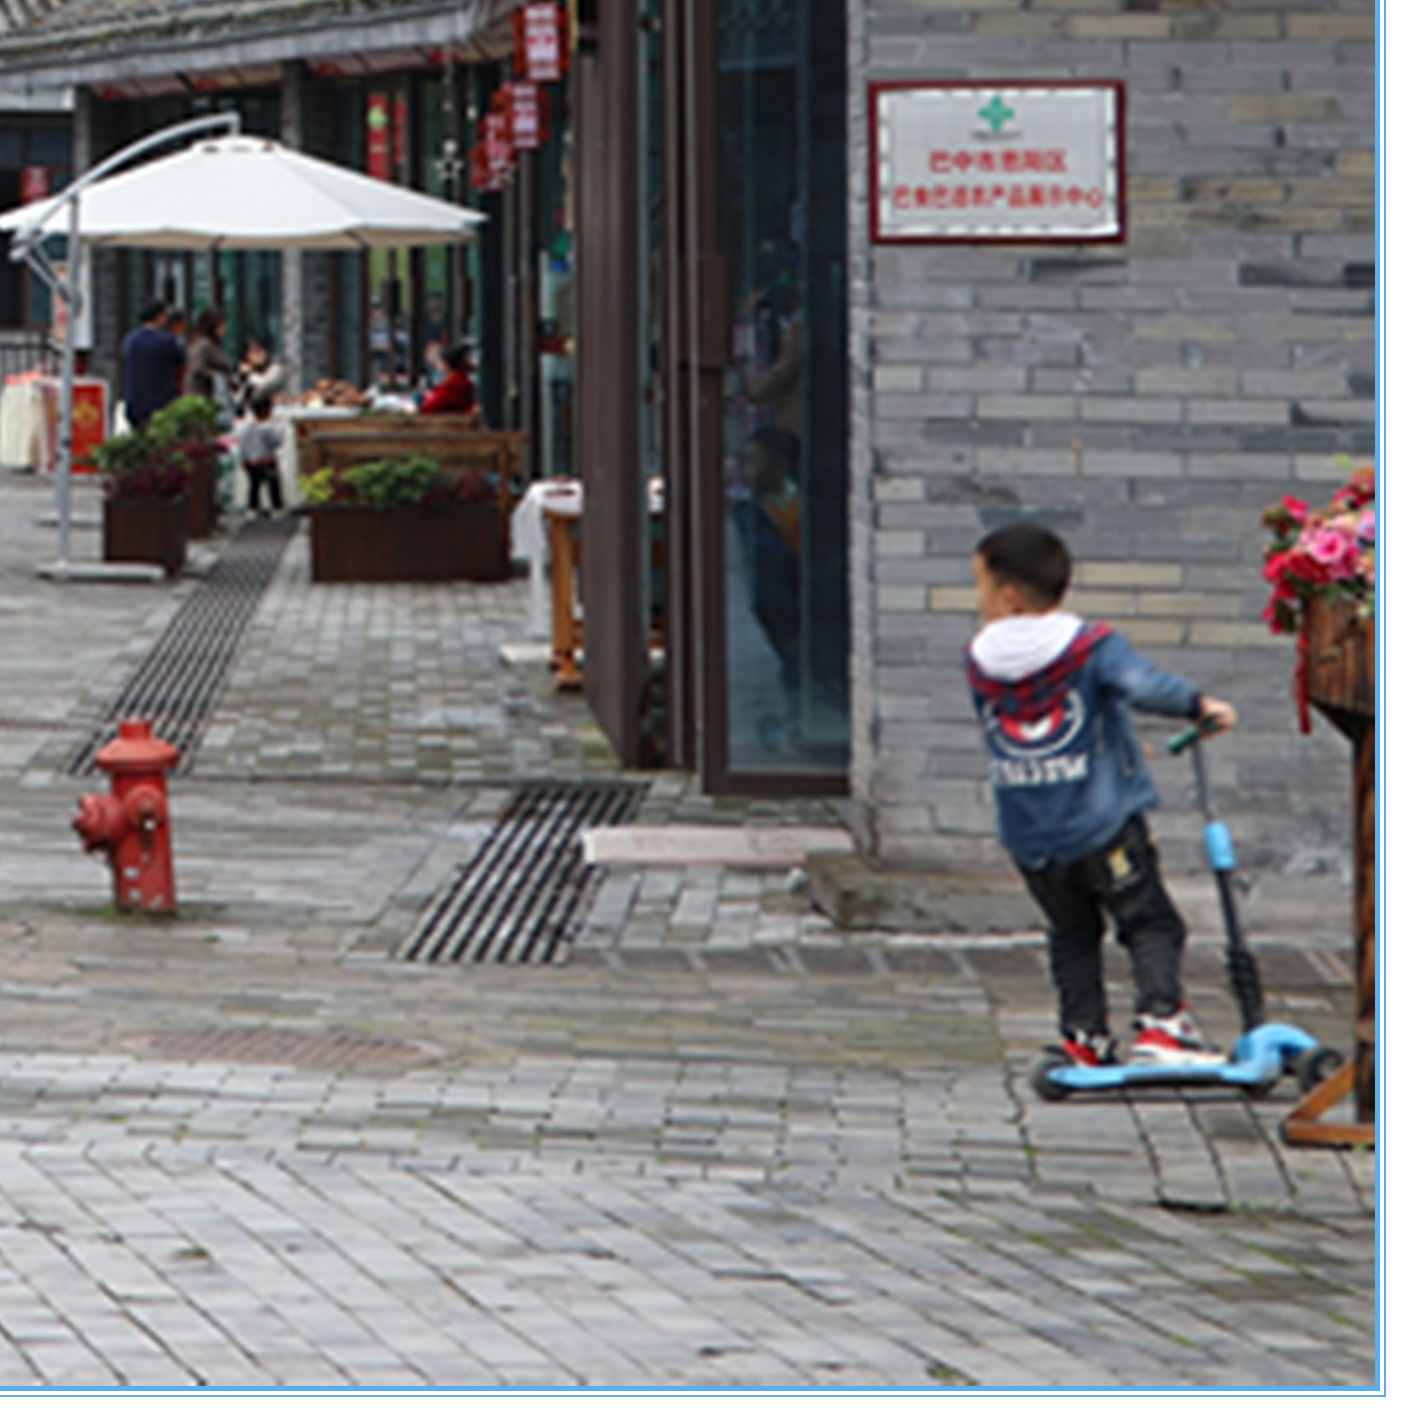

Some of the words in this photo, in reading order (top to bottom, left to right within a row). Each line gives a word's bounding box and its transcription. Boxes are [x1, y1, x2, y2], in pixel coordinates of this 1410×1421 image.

[928, 148, 1068, 174] 巴中市恩阳区
